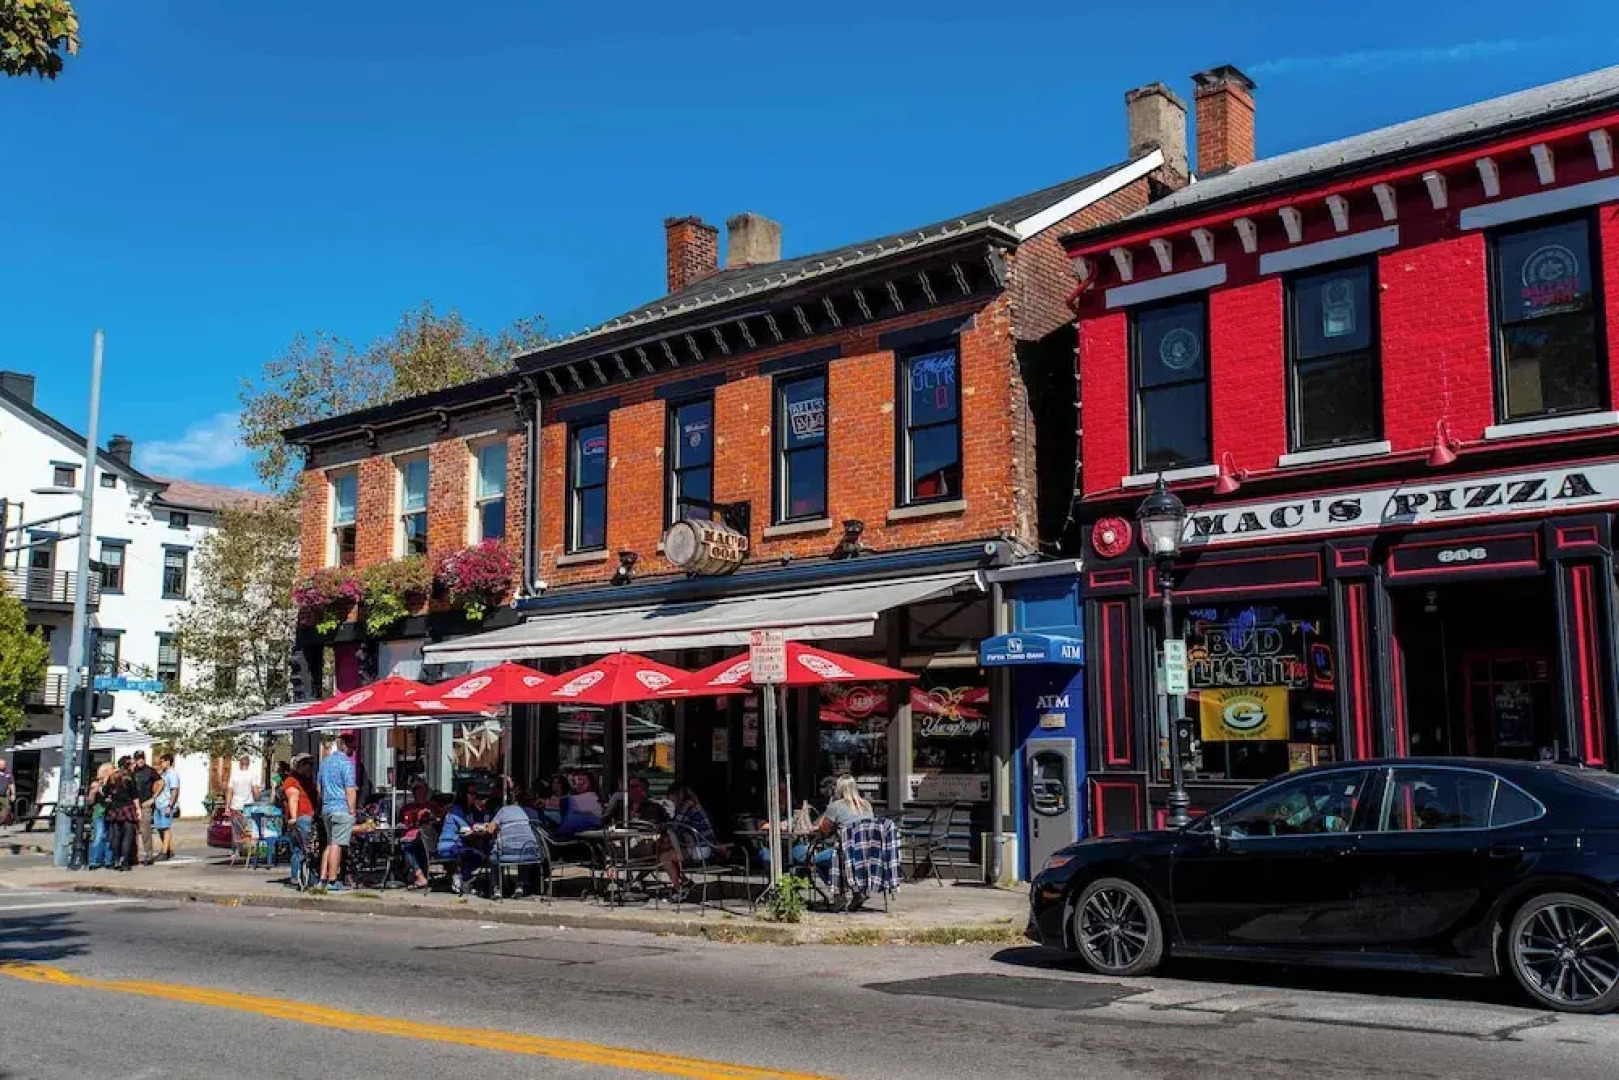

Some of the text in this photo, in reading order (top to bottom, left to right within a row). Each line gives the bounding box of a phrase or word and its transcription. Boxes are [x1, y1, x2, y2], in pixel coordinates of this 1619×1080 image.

[911, 368, 955, 390] ULTR
[1190, 473, 1602, 537] MAC'S PIZZA
[701, 528, 748, 551] MAC'S
[1438, 547, 1487, 562] 606
[1205, 627, 1283, 655] BUD
[1026, 651, 1045, 660] BANK
[1061, 645, 1080, 660] ATM
[1192, 656, 1301, 687] LIGHT
[1036, 695, 1070, 709] ATM
